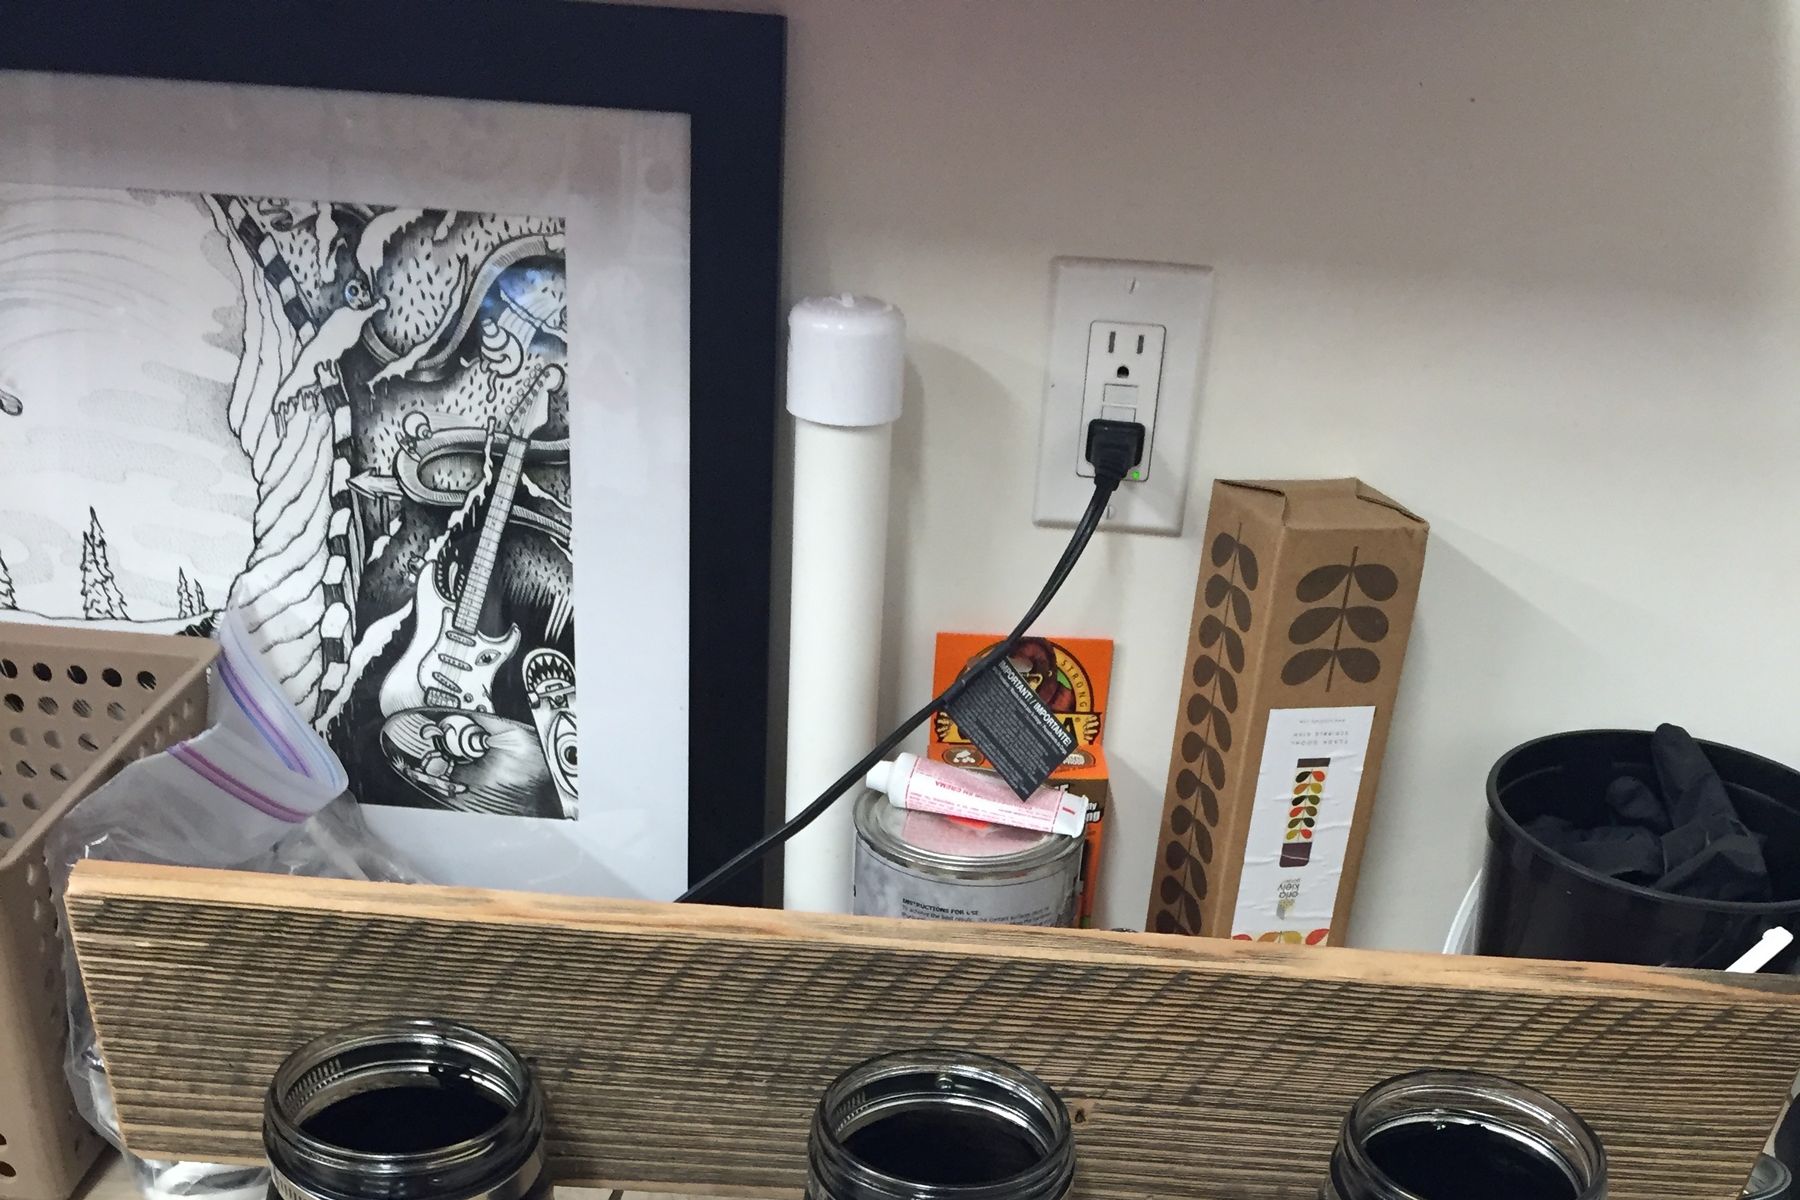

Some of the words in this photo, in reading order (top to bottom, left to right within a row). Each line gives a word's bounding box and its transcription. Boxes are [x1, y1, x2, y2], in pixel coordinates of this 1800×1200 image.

[999, 660, 1034, 699] IMPORTANT!
[1033, 702, 1072, 747] IMPORTANTE!
[1061, 660, 1088, 708] STRONG
